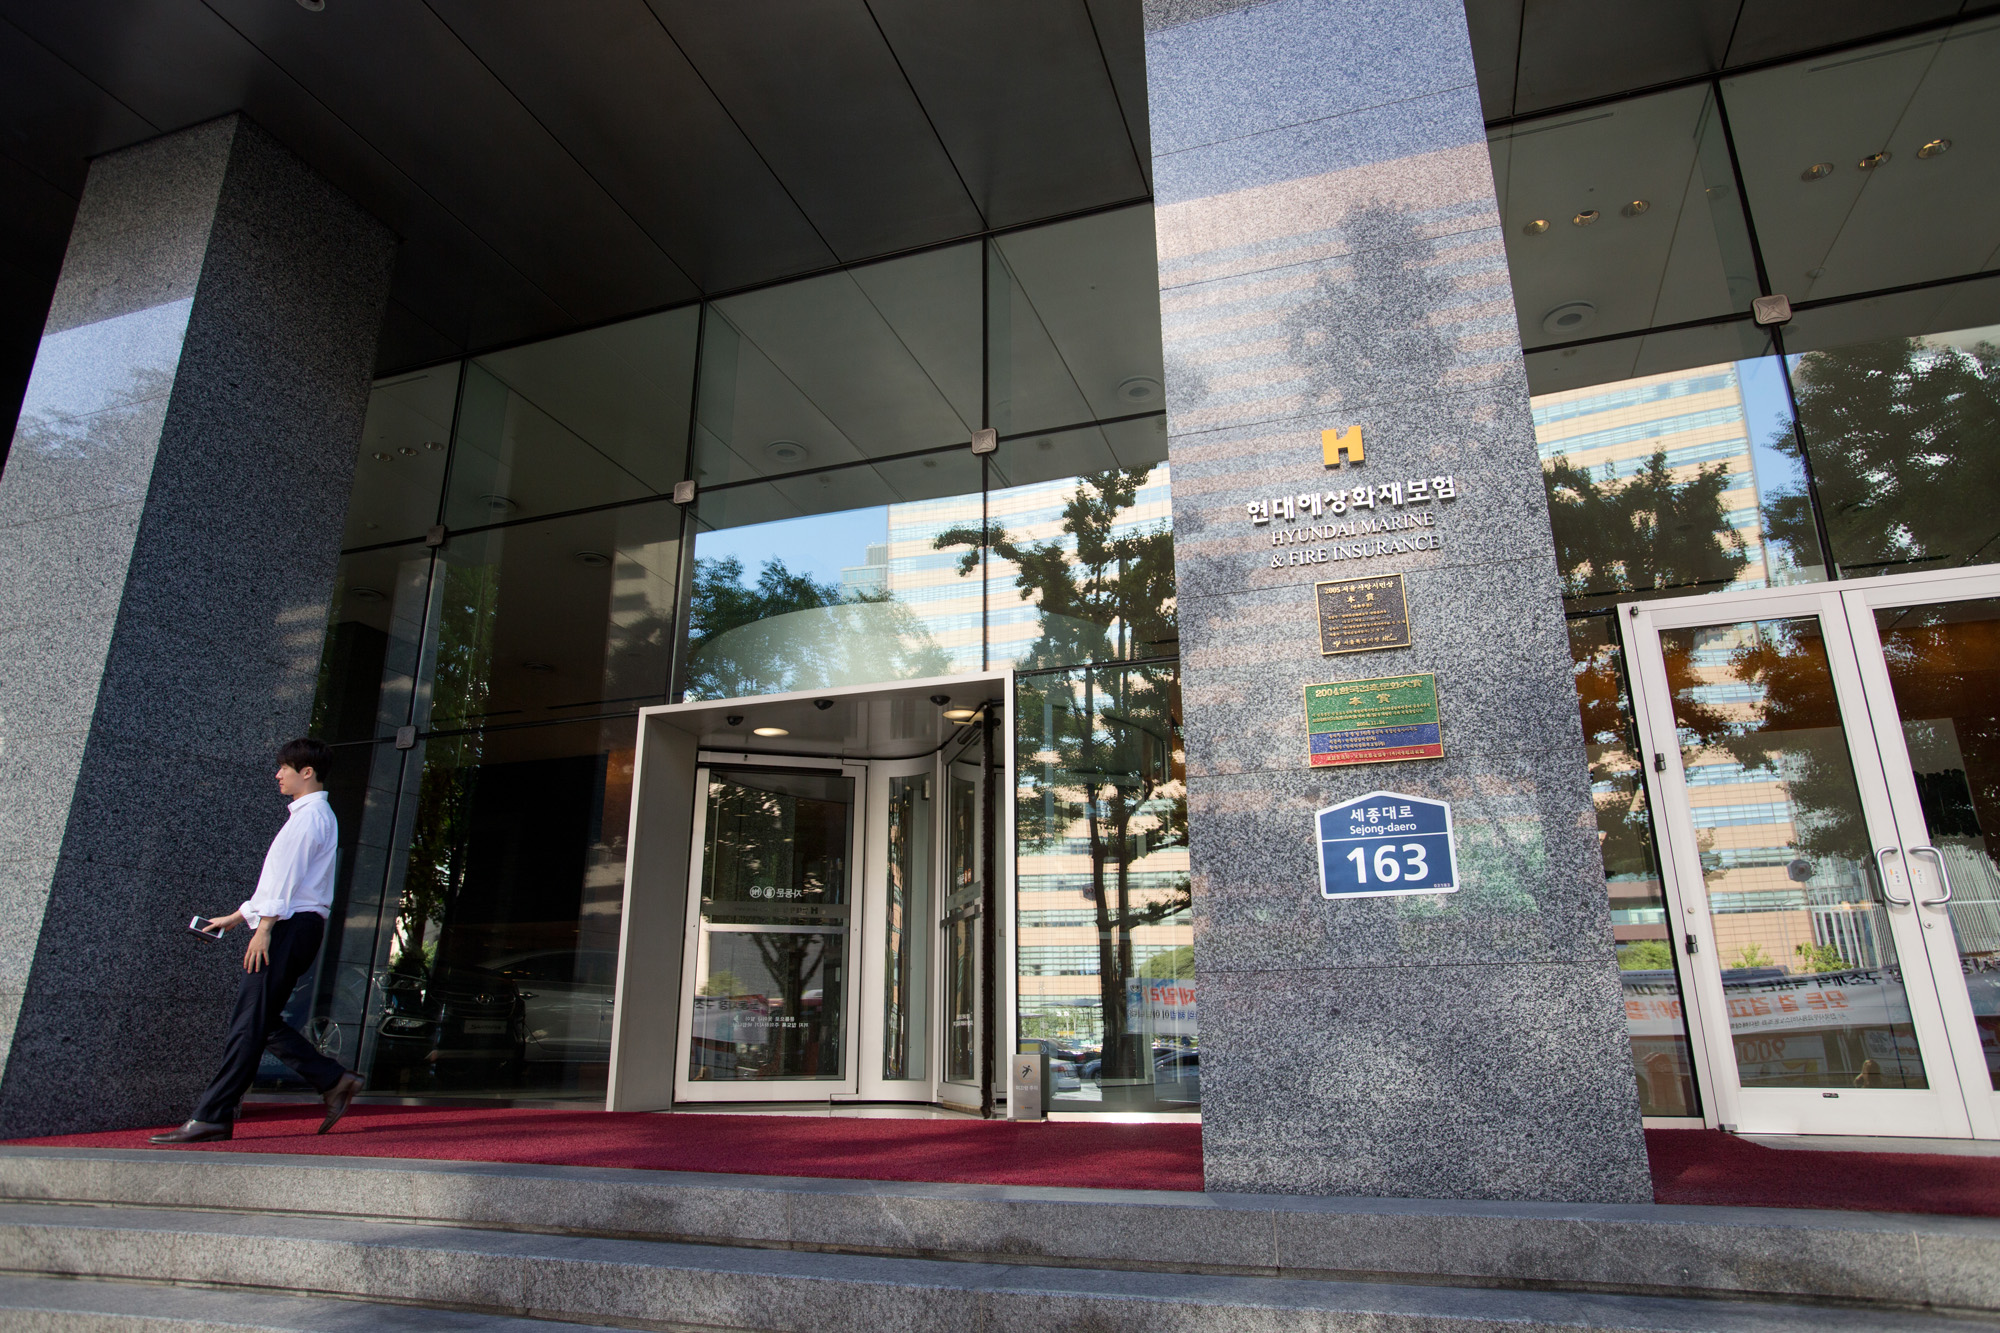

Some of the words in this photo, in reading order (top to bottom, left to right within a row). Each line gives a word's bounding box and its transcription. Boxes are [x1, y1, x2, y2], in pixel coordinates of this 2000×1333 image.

[1247, 476, 1456, 524] 현대해상화재보험
[1272, 522, 1355, 546] HYUNDAI
[1360, 512, 1435, 535] MARINE
[1271, 553, 1285, 568] &
[1289, 549, 1328, 566] FIRE
[1333, 535, 1440, 561] INSURANCE
[1350, 805, 1414, 824] 세종대로
[1350, 822, 1417, 836] Sejong-daero
[1346, 843, 1429, 884] 163
